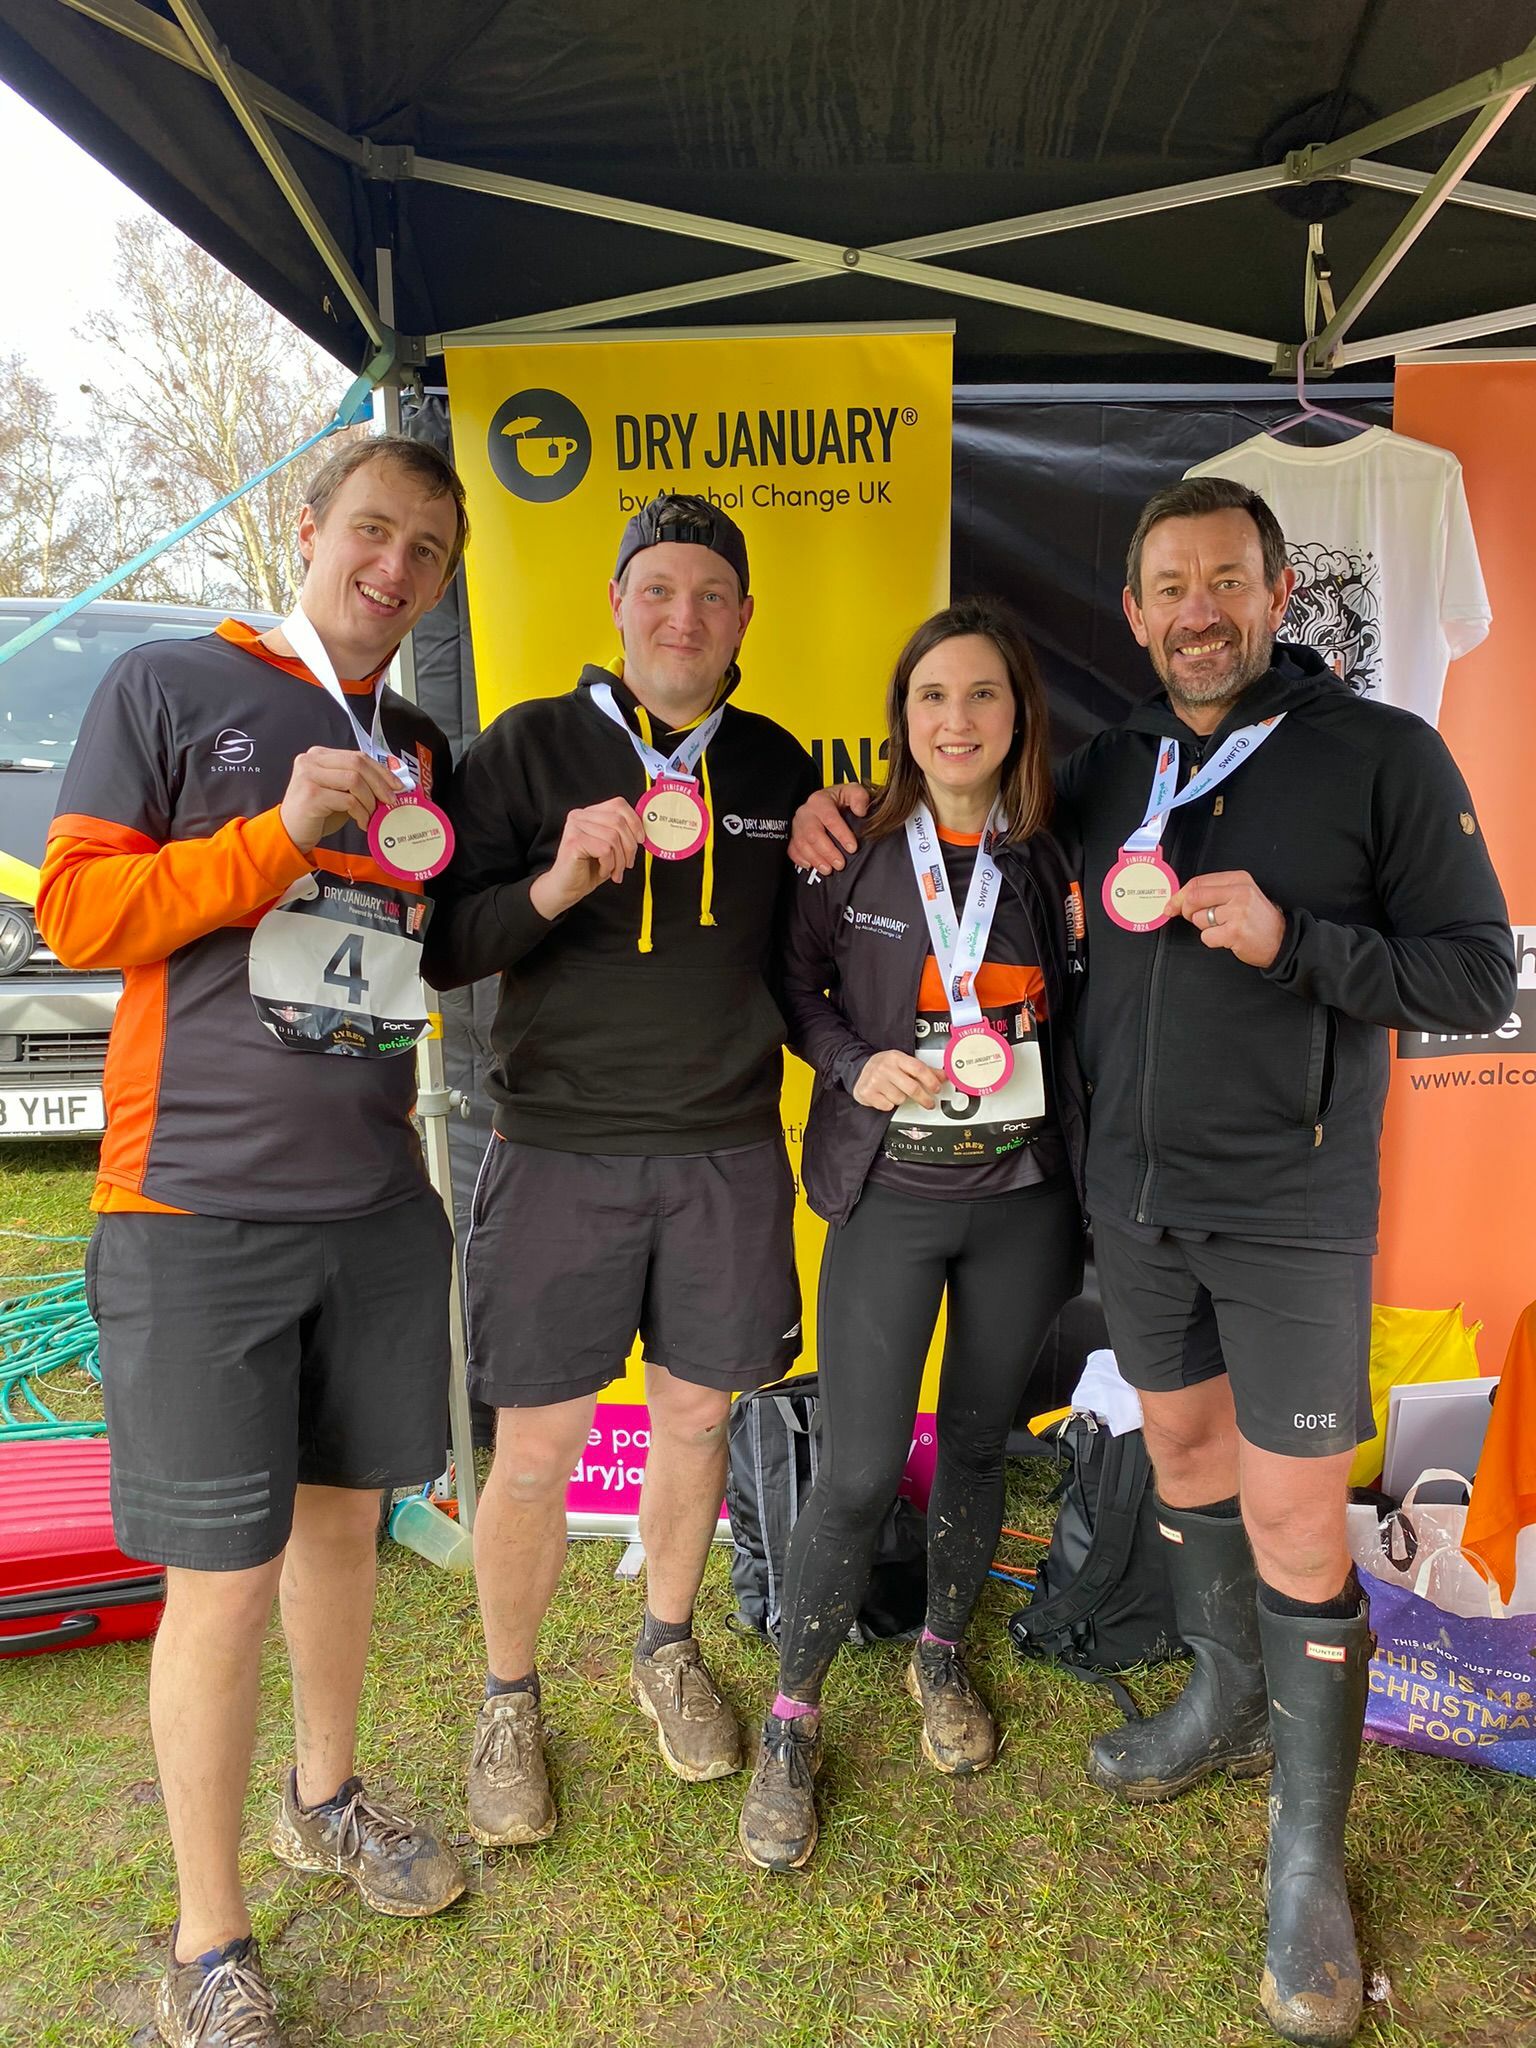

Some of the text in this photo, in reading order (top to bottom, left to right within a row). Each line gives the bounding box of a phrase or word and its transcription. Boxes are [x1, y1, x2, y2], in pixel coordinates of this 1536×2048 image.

[616, 413, 698, 471] DRY
[619, 488, 648, 511] by
[752, 484, 850, 511] Change
[858, 481, 892, 504] UK
[211, 765, 261, 773] SCIMITAR
[1219, 747, 1240, 769] SWIFT
[663, 783, 691, 795] FINISHER
[744, 818, 758, 830] DRY
[914, 817, 928, 841] SWIFT
[660, 850, 675, 859] 2024
[1126, 856, 1155, 865] FINISHER
[415, 870, 432, 880] 2024
[324, 886, 343, 900] DRY
[384, 901, 400, 917] 10K
[978, 879, 990, 908] SWIFT
[856, 912, 872, 923] DRY
[324, 934, 369, 1005] 4
[934, 1021, 949, 1033] DRY
[958, 1027, 985, 1038] FINISHER
[19, 1096, 87, 1126] YHF
[891, 1142, 943, 1153] GODHEAD
[1294, 1413, 1337, 1430] GORE
[1373, 1647, 1438, 1681] THIS
[1448, 1670, 1475, 1693] IS
[1392, 1638, 1531, 1683] THIS IS NOT JUST FOOD
[1369, 1670, 1536, 1731] CHRISTMA
[1408, 1713, 1500, 1747] FOOD
